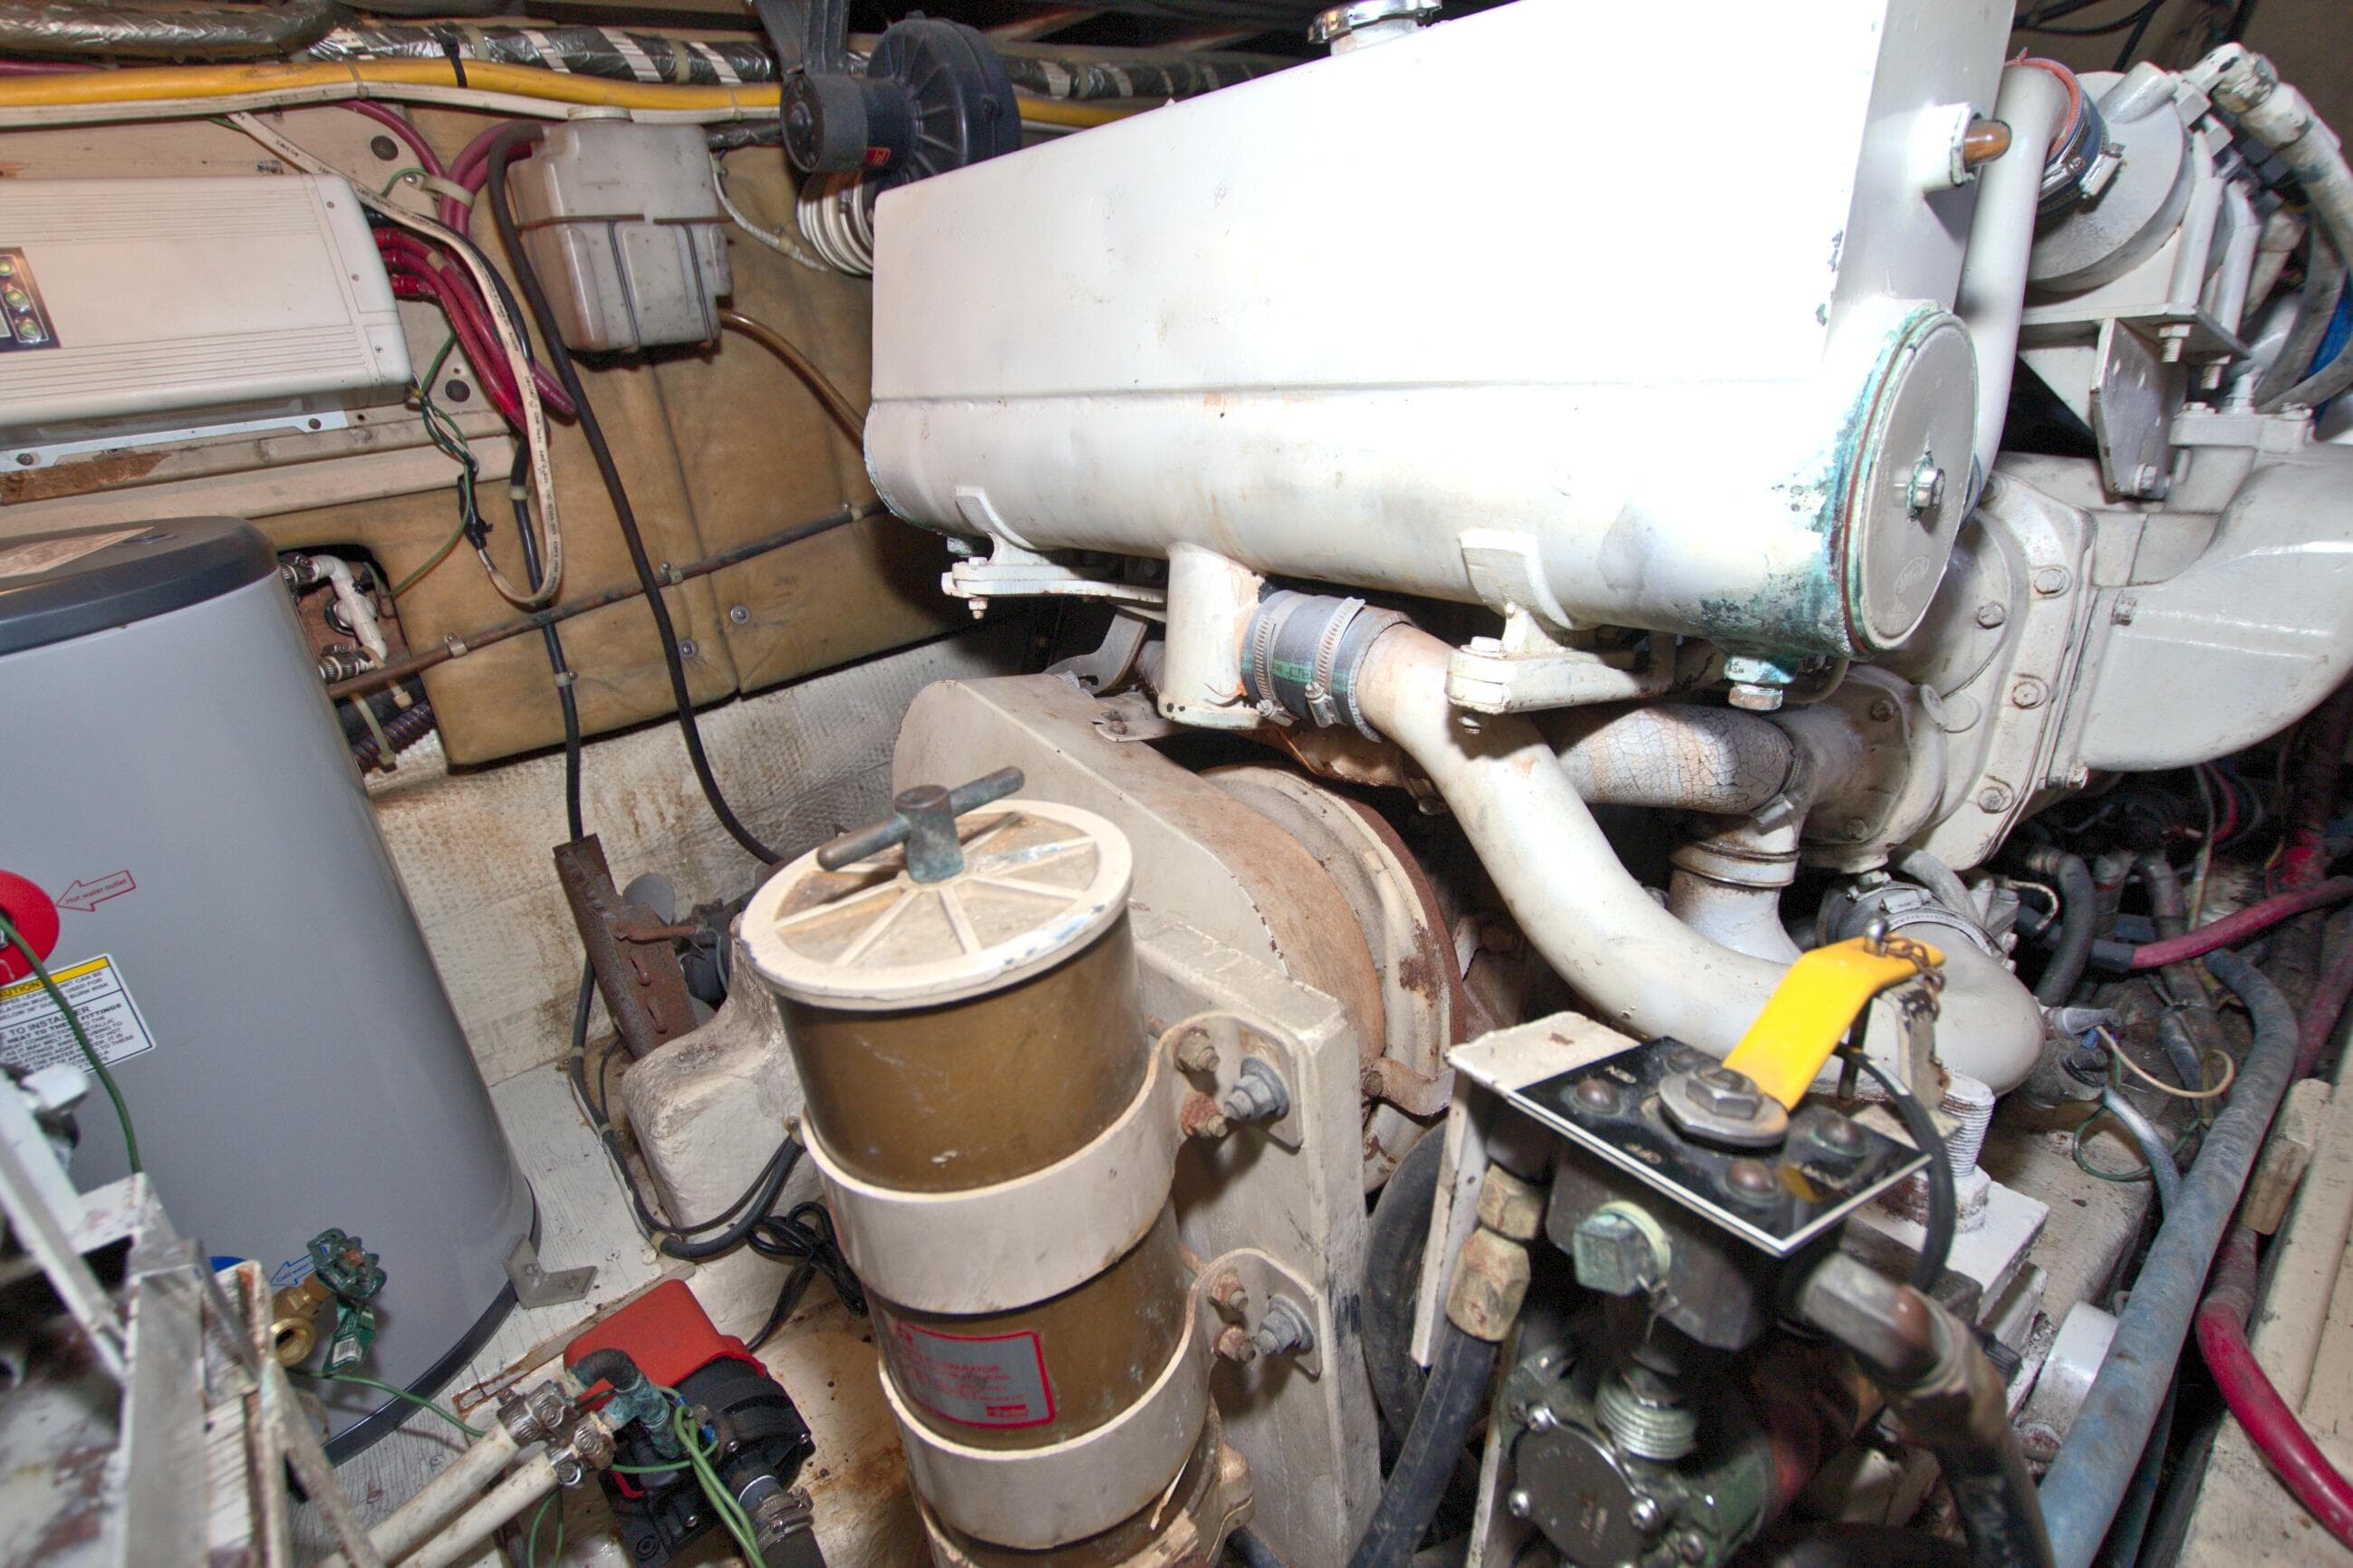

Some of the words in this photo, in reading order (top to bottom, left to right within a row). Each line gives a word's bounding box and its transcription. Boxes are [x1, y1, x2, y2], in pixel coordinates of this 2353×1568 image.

[105, 879, 125, 890] outlet
[0, 979, 40, 997] AUTION
[80, 1003, 121, 1019] FITTINGS
[9, 1026, 25, 1036] TO
